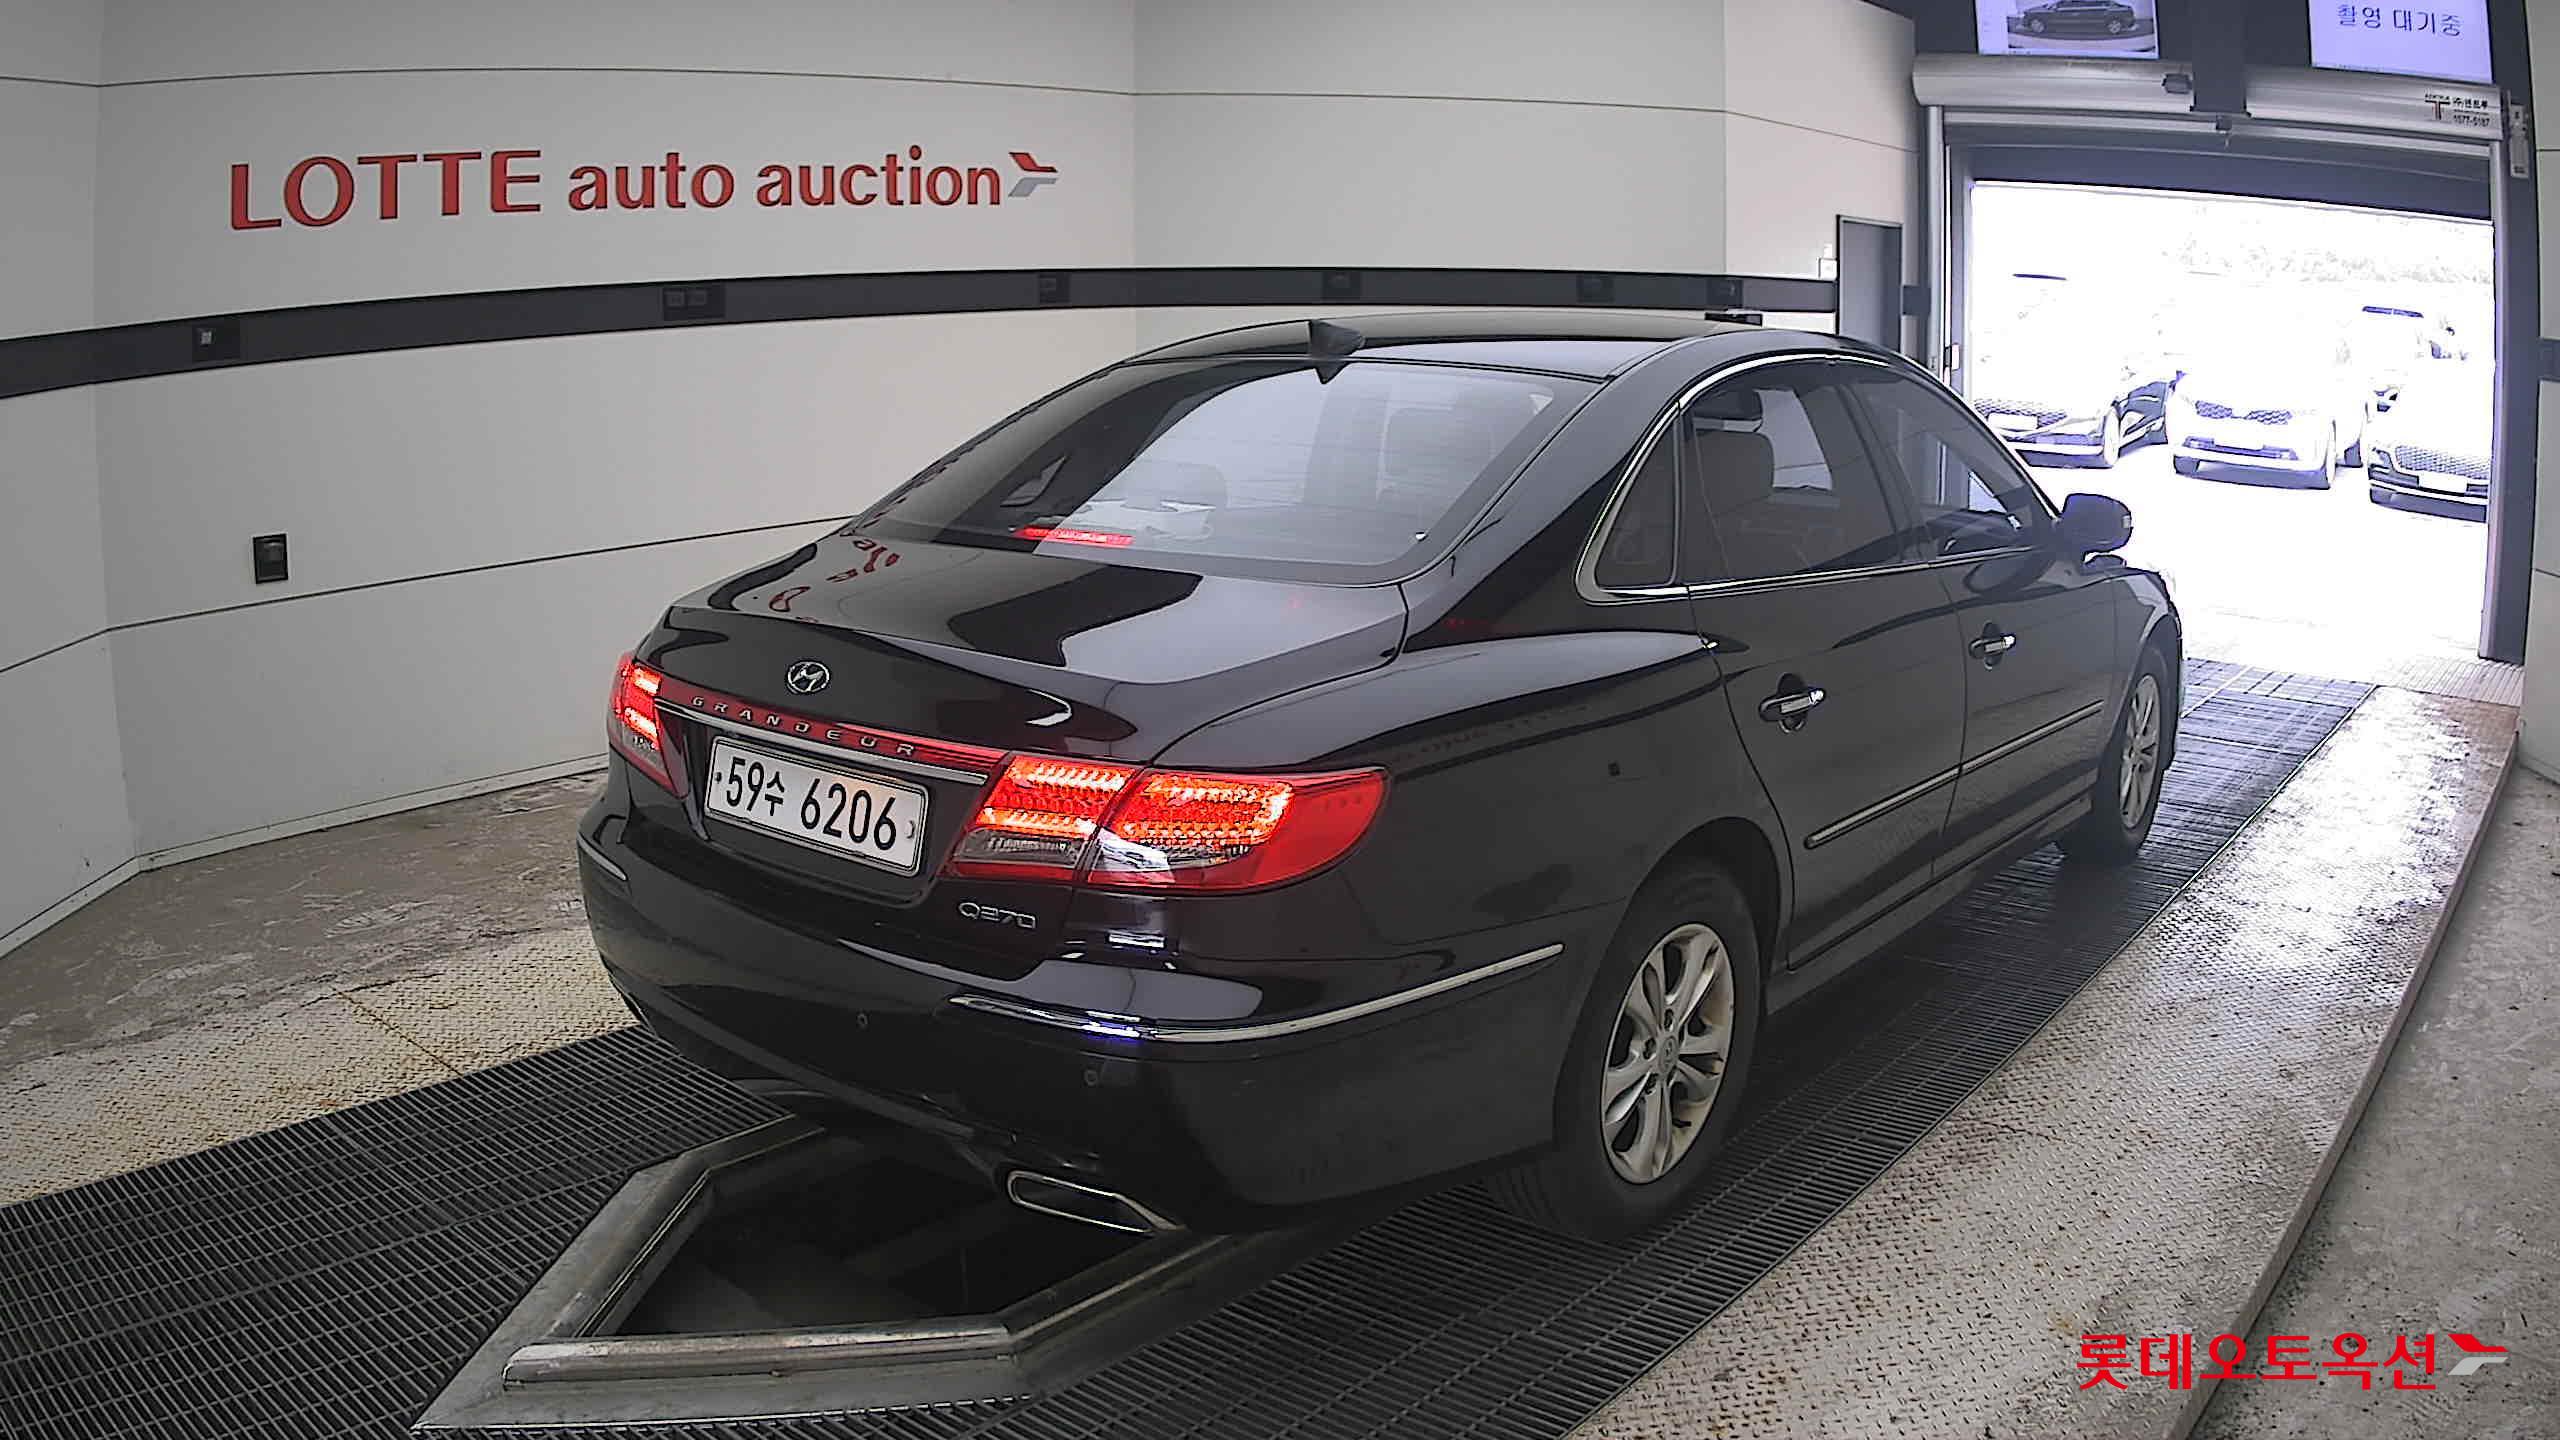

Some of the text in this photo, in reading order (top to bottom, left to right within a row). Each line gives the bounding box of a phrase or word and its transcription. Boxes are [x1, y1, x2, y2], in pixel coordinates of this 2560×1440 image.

[2338, 5, 2462, 37] 촬영 대기중
[231, 145, 1002, 231] LOTTE auto auction
[692, 696, 915, 756] GRANDEUR
[726, 756, 897, 851] 59수 6206
